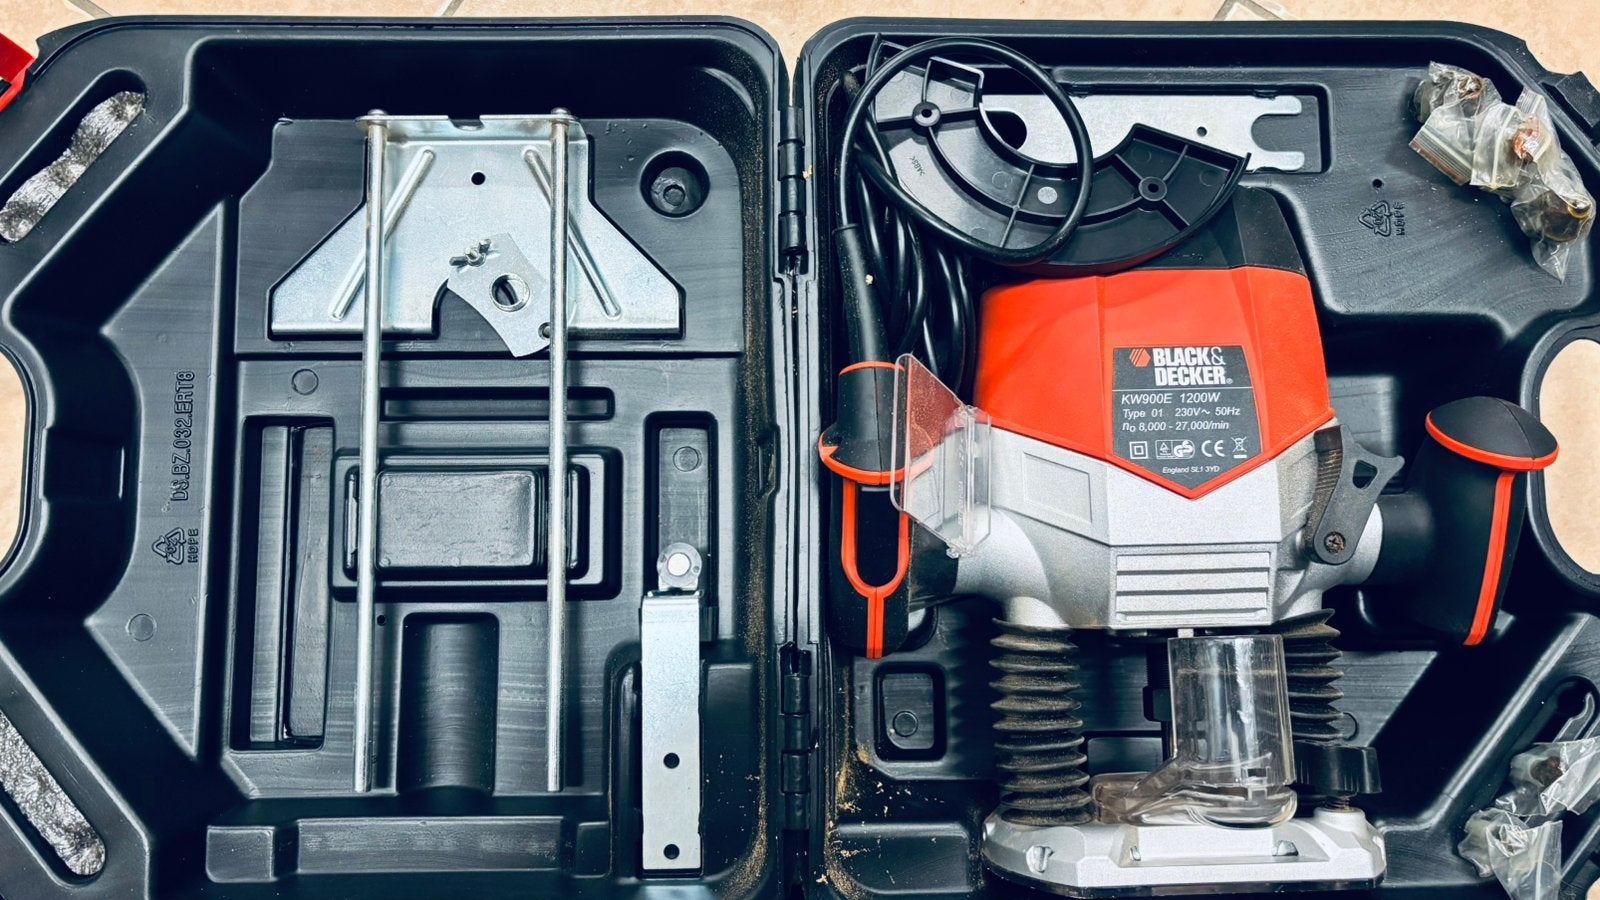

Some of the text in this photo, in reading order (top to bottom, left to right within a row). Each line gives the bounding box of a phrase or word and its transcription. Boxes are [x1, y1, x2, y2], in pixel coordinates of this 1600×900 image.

[1121, 392, 1221, 405] KW900E 1200W
[1122, 409, 1146, 420] Type
[1151, 409, 1163, 418] 01
[1215, 407, 1241, 416] 50Hz
[1138, 421, 1167, 432] 8,000
[1175, 420, 1229, 432] 27,000/min
[170, 370, 195, 501] DS.BZ.032.ERT8
[1162, 466, 1190, 474] England
[1205, 465, 1220, 473] 3YD
[187, 528, 199, 564] HDPE
